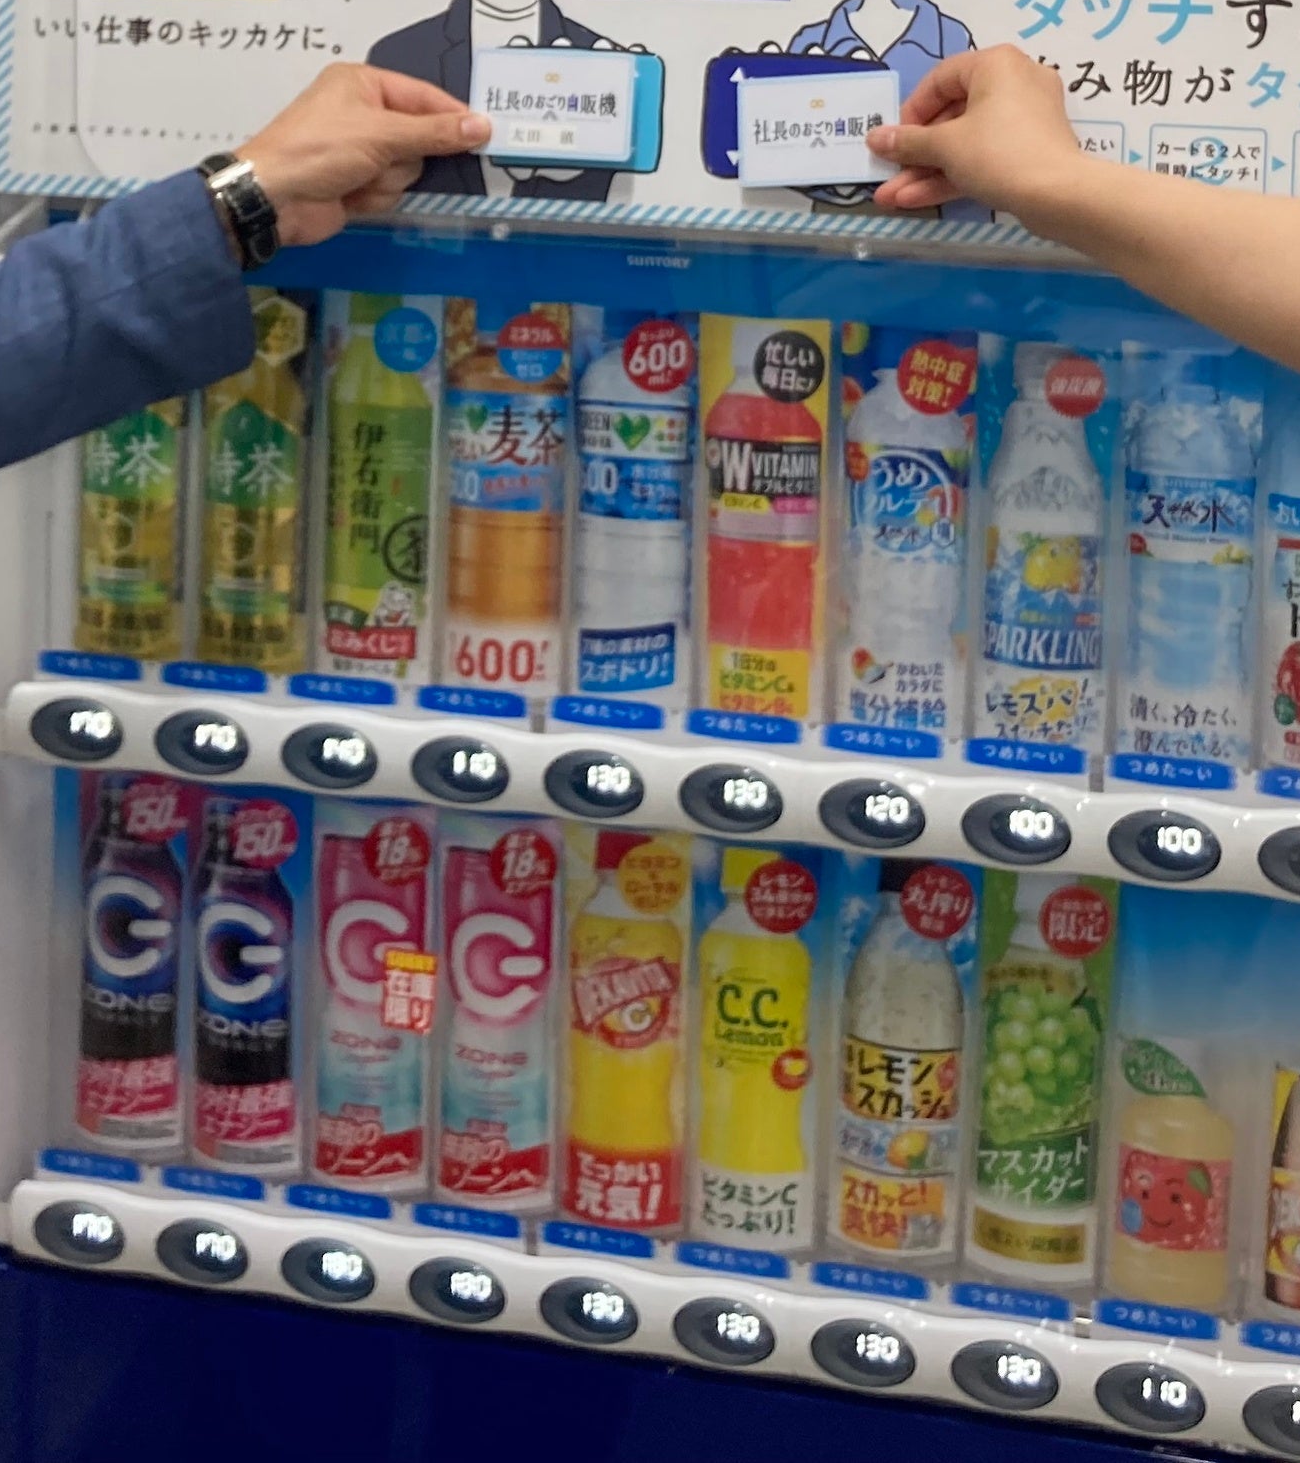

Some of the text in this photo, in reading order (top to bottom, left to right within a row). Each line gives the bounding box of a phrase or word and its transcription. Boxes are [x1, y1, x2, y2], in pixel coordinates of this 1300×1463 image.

[33, 14, 345, 58] いい仕事のキッカケに。
[486, 87, 618, 119] 社長のおごり自販機
[628, 340, 688, 376] 600
[763, 341, 816, 368] 忙しい
[762, 367, 816, 393] 毎日に!
[486, 403, 564, 467] 麦茶
[871, 458, 930, 489] うめ
[1141, 493, 1234, 533] 天然水
[455, 635, 535, 683] 600
[582, 652, 670, 684] スポドリ!
[849, 688, 946, 730] 塩分補給
[725, 780, 766, 807] 130
[866, 793, 908, 822] 120
[1010, 810, 1052, 838] 100
[1158, 827, 1201, 854] 100
[717, 983, 789, 1030] C.C.
[858, 1053, 934, 1087] レモン
[977, 1138, 1090, 1173] マスカット
[575, 1178, 664, 1221] 元気!
[702, 1170, 798, 1206] ビタミンC
[990, 1172, 1085, 1207] サイダー
[718, 1313, 759, 1340] 130
[857, 1334, 898, 1360] 130
[999, 1356, 1040, 1383] 130
[1143, 1379, 1186, 1405] 110
